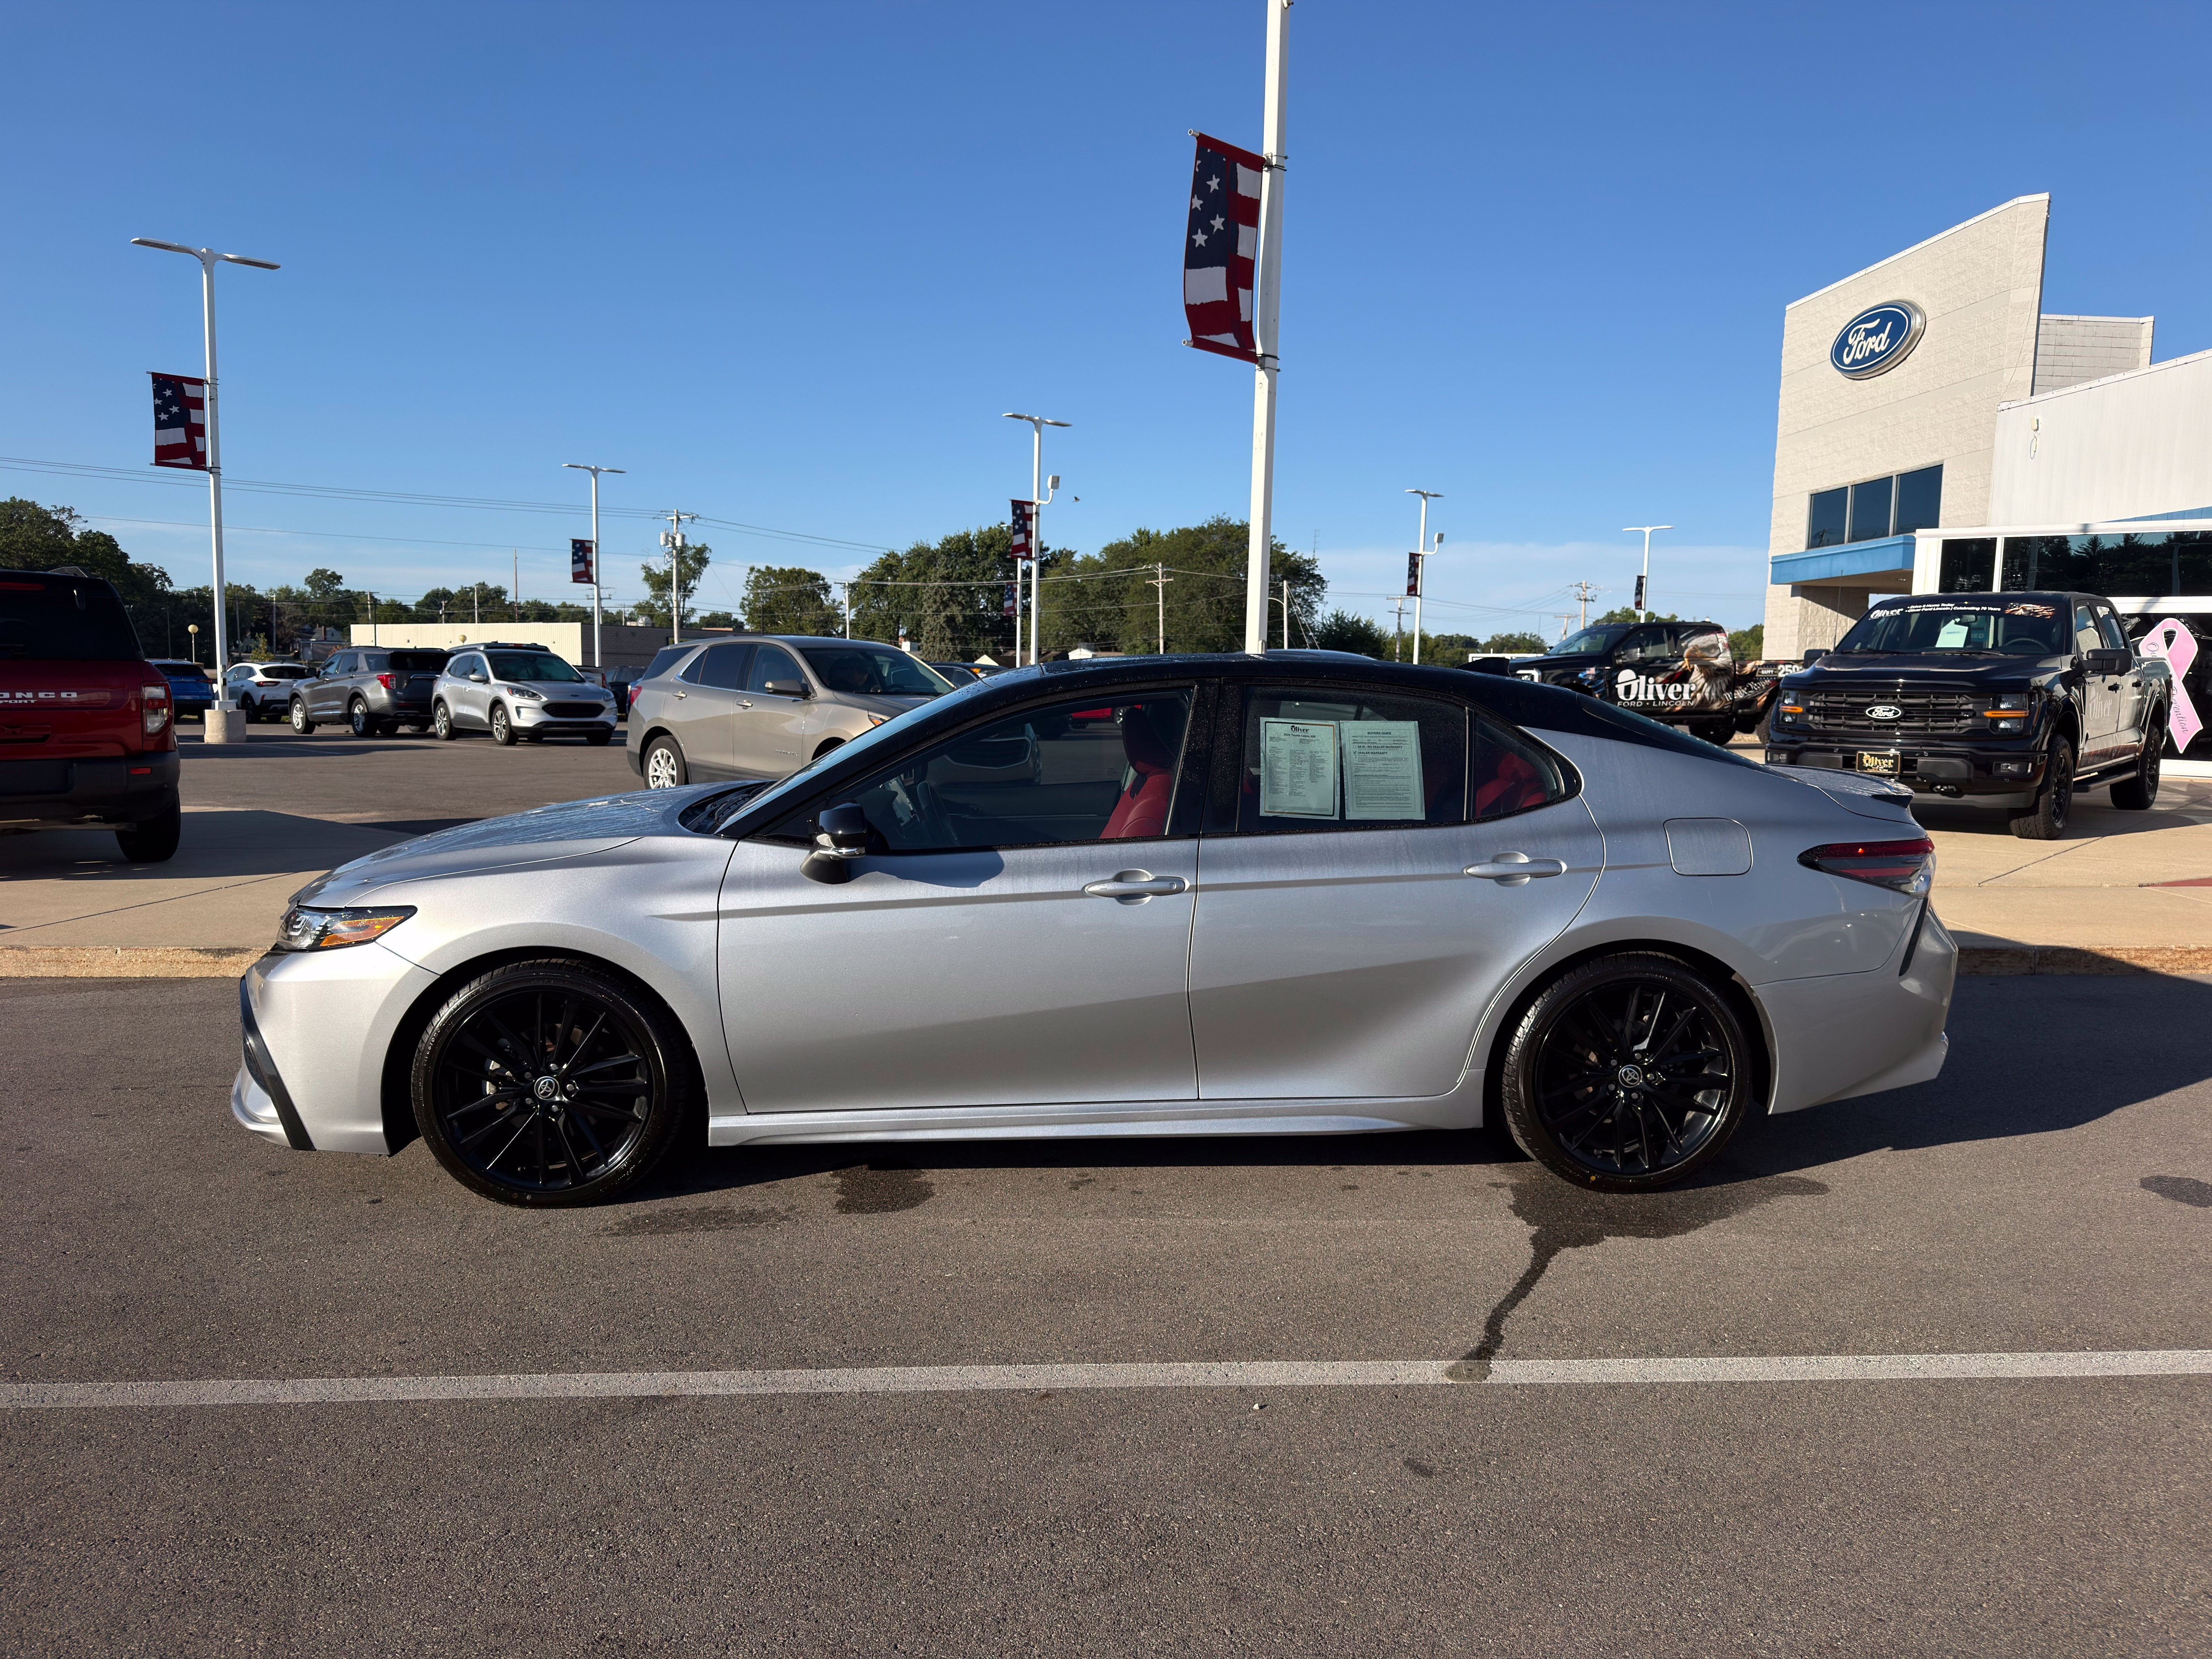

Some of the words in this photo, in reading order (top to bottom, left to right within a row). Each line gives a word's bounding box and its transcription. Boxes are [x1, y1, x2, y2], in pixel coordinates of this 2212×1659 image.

[1843, 318, 1892, 365] Ford
[1870, 608, 1903, 618] Oliver
[1615, 669, 1696, 701] Oliver
[1872, 708, 1894, 716] Ford
[2089, 686, 2112, 720] Oliver
[1863, 754, 1894, 766] Oliver
